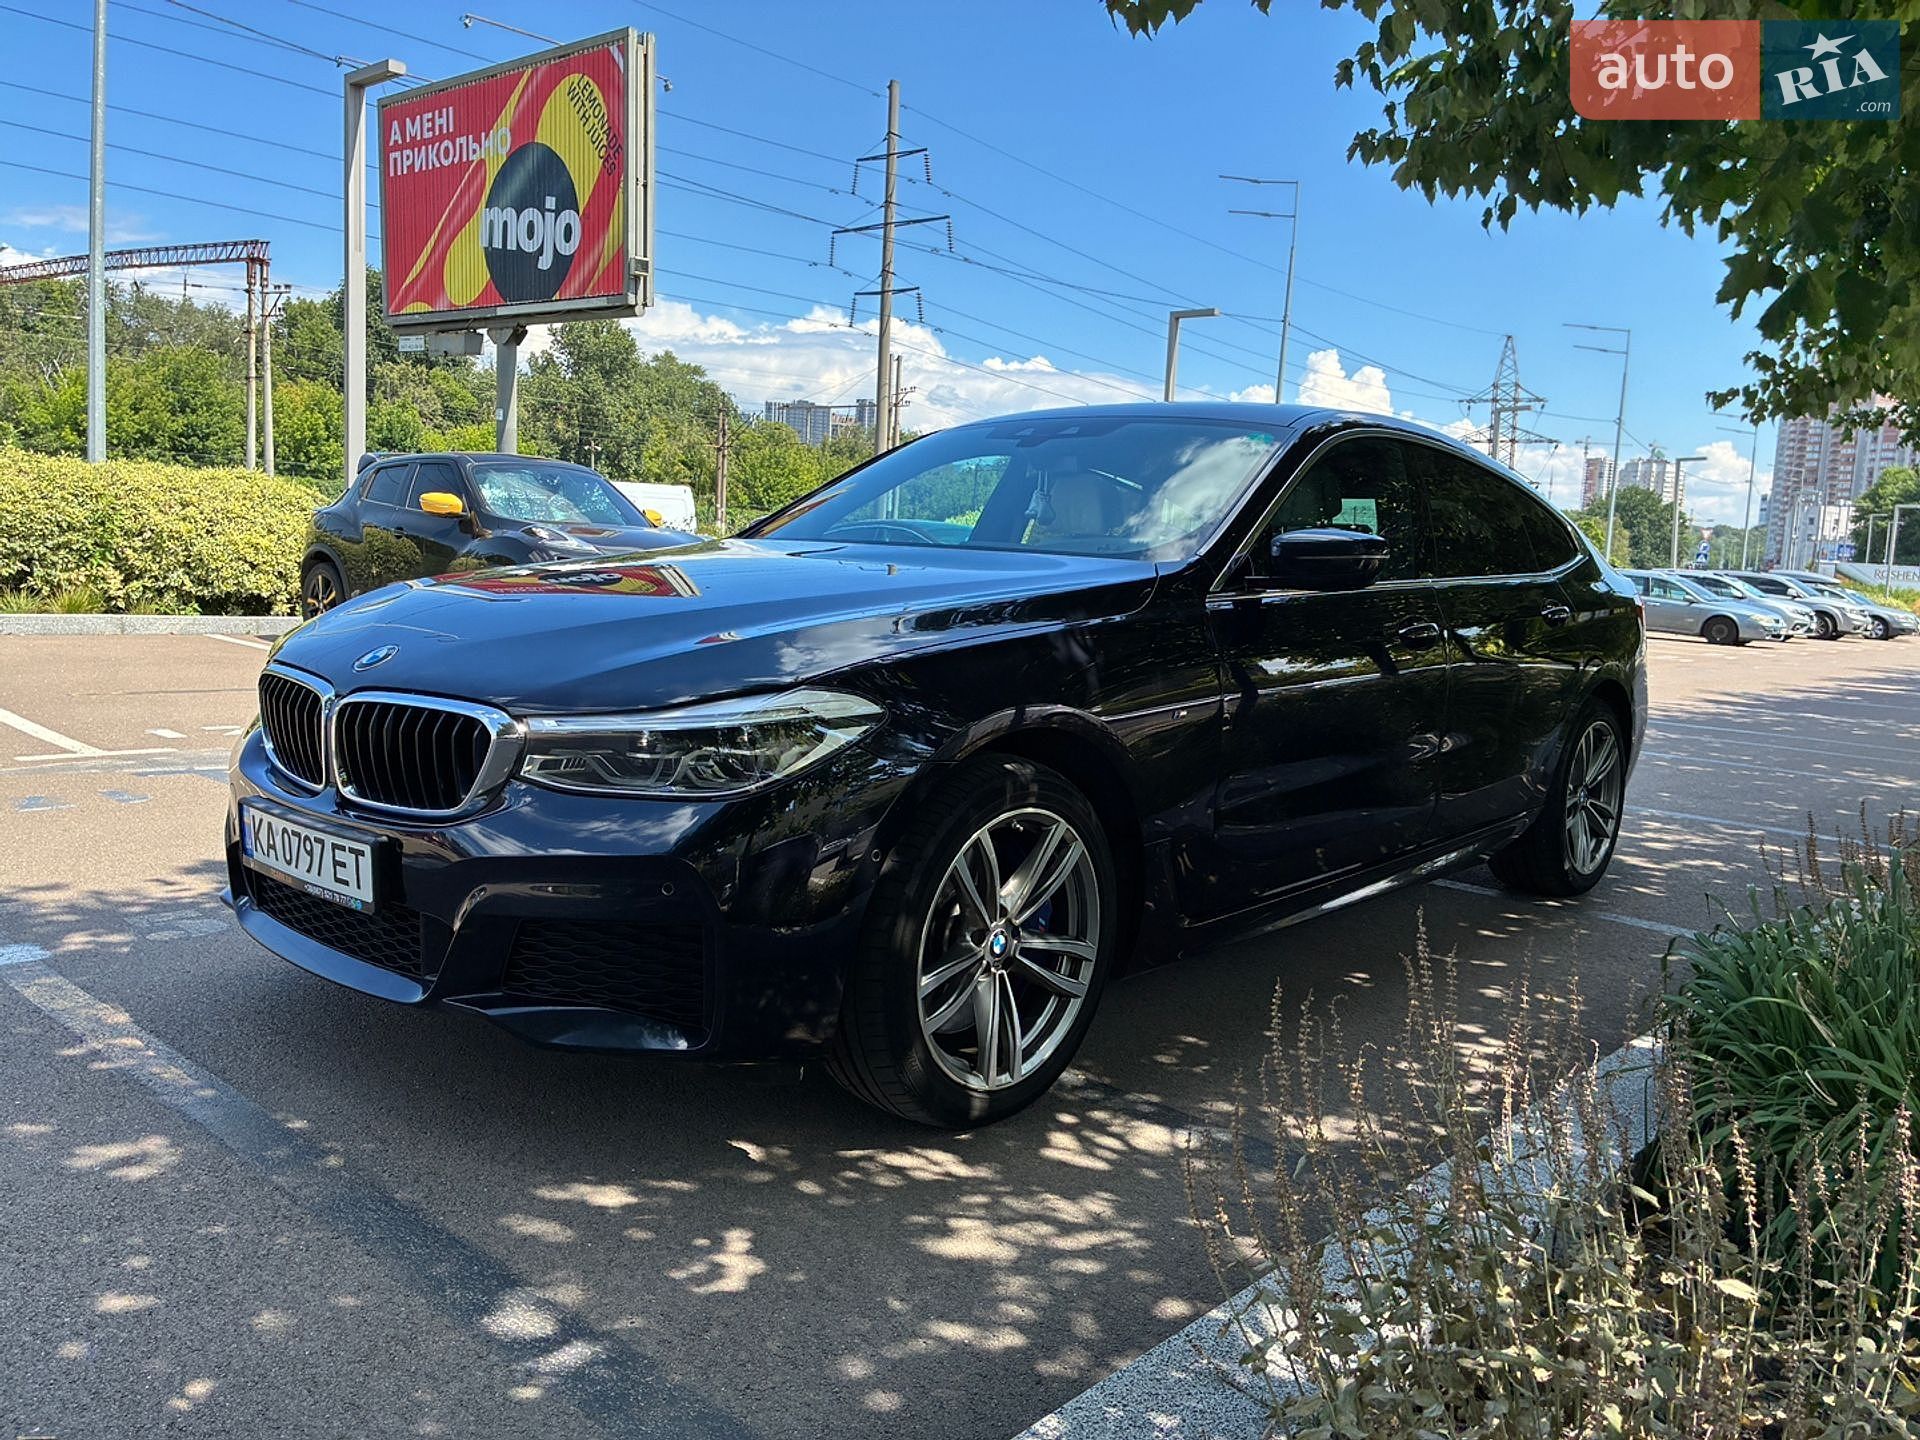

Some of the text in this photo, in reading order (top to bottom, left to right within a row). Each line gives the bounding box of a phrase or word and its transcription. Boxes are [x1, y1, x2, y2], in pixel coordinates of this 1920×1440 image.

[389, 106, 453, 146] А МЕНІ
[389, 127, 511, 177] ПРИКОЛЬНО
[567, 81, 616, 176] WITH JUICES
[577, 73, 622, 160] LEMONADE
[480, 196, 582, 270] mojo
